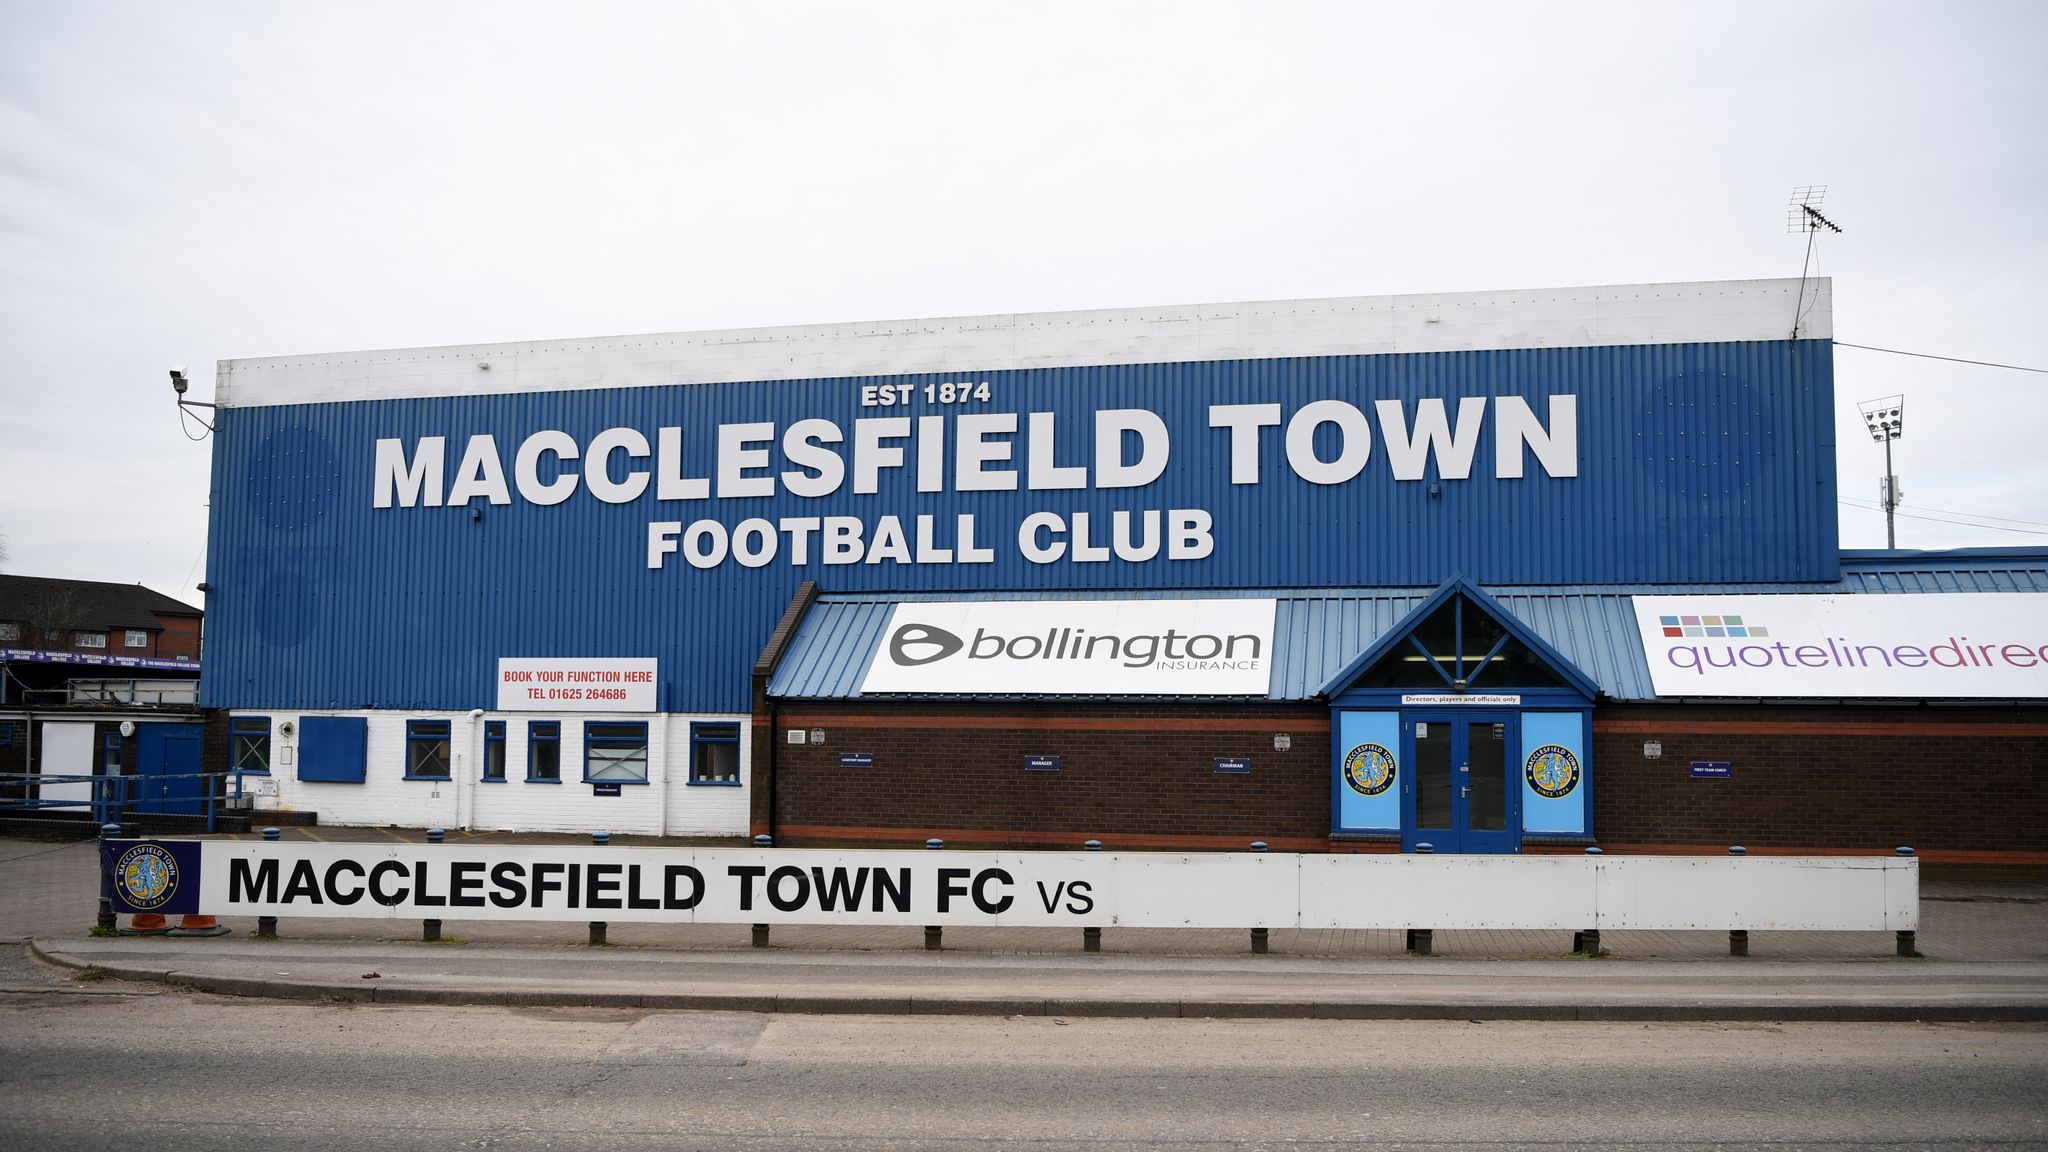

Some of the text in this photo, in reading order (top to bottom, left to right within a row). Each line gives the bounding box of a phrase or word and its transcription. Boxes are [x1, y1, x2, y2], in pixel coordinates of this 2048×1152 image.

[861, 381, 991, 406] EST 1874
[373, 394, 1578, 508] MACCLESFIELD TOWN
[647, 509, 1214, 569] FOOTBALL CLUB
[967, 627, 1261, 668] bollington
[1667, 635, 2048, 674] quotelinedire
[503, 671, 653, 683] BOOK YOUR FUNCTION HERE
[1156, 660, 1260, 671] INSURANCE
[527, 688, 627, 700] TEL 01625 264686
[1502, 696, 1517, 704] only
[1346, 745, 1394, 769] MACCLESFIELD TOWN
[1527, 746, 1578, 771] MACCLESFIELD TOWN
[1355, 784, 1370, 793] SINCE
[1537, 787, 1569, 796] SINCE 1874
[118, 846, 176, 876] MACCLESFIELD TOWN
[228, 858, 1094, 915] MACCLESFIELD TOWN FC VS
[127, 895, 147, 907] SINCE
